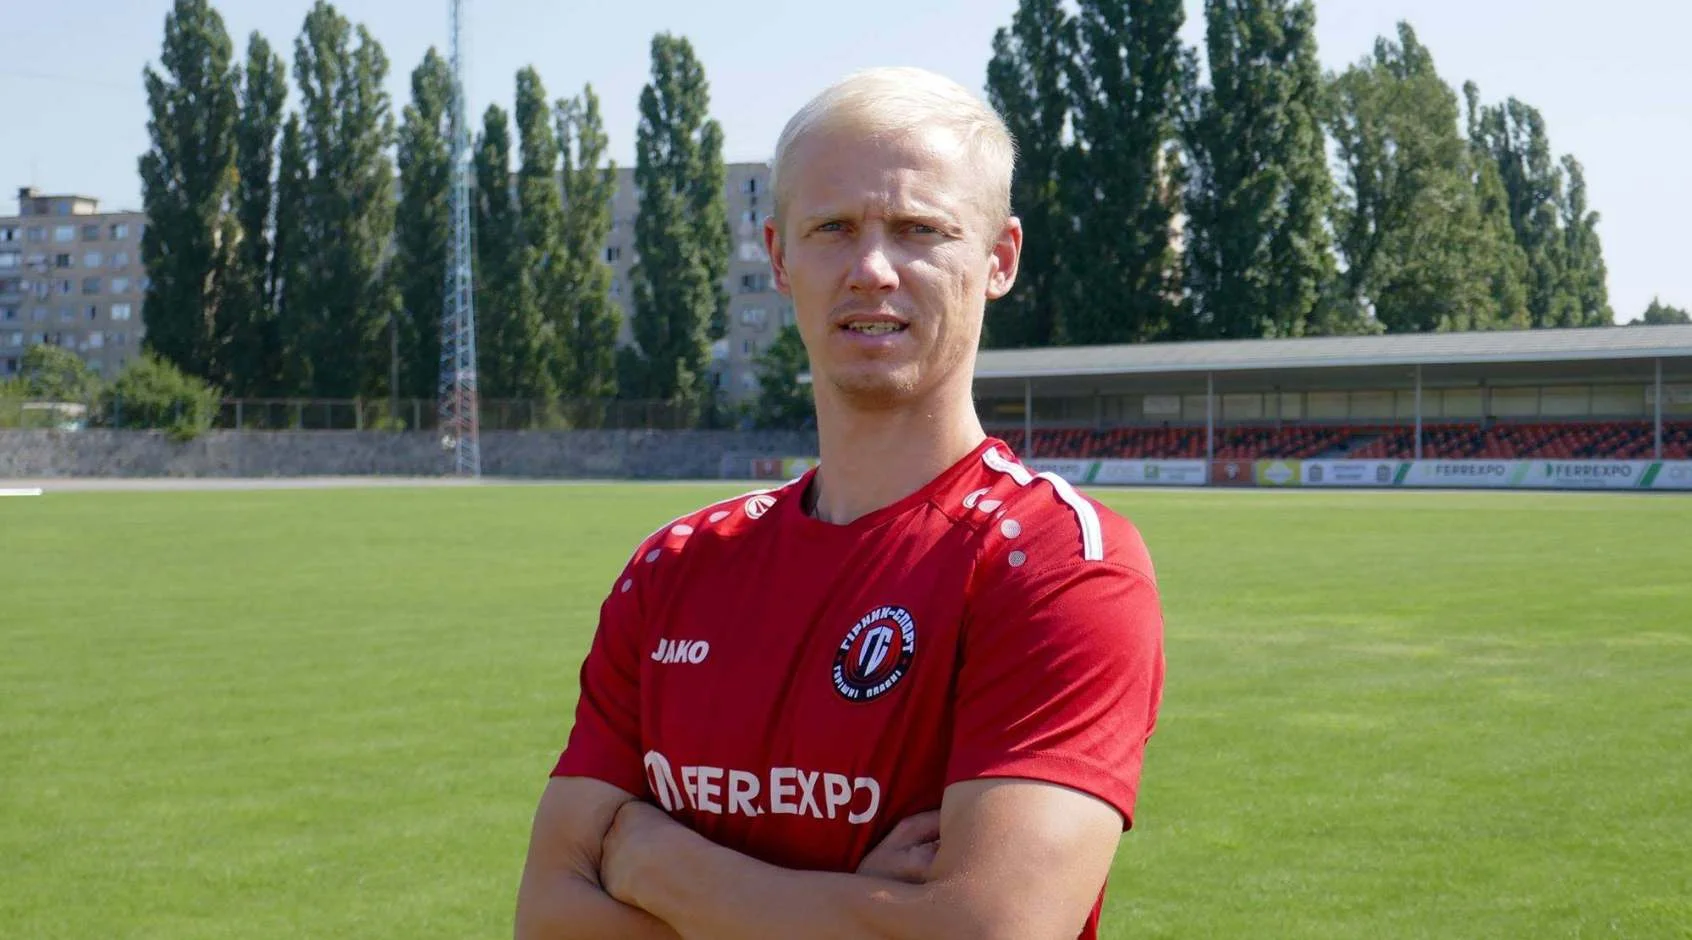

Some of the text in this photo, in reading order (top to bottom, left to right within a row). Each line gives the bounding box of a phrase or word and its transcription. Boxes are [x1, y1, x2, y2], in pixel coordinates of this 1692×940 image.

[1555, 463, 1632, 477] FERREXPO
[651, 638, 710, 664] JAKO
[680, 765, 881, 825] FEREXPO
